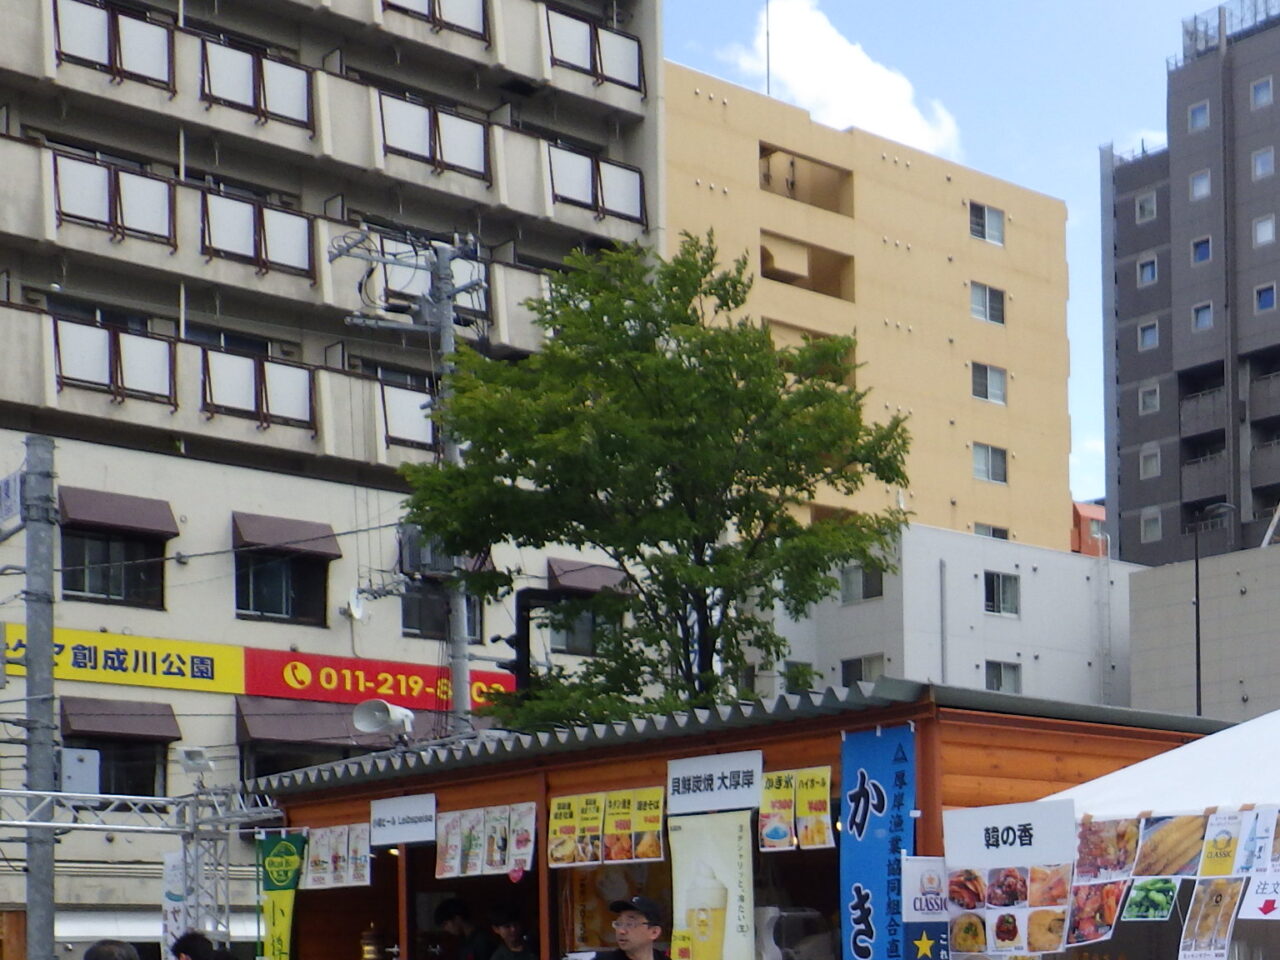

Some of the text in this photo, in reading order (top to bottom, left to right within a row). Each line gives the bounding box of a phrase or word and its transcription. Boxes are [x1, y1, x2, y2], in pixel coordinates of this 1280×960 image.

[319, 667, 505, 703] 011-219-80
[984, 823, 1034, 849] 韓の香
